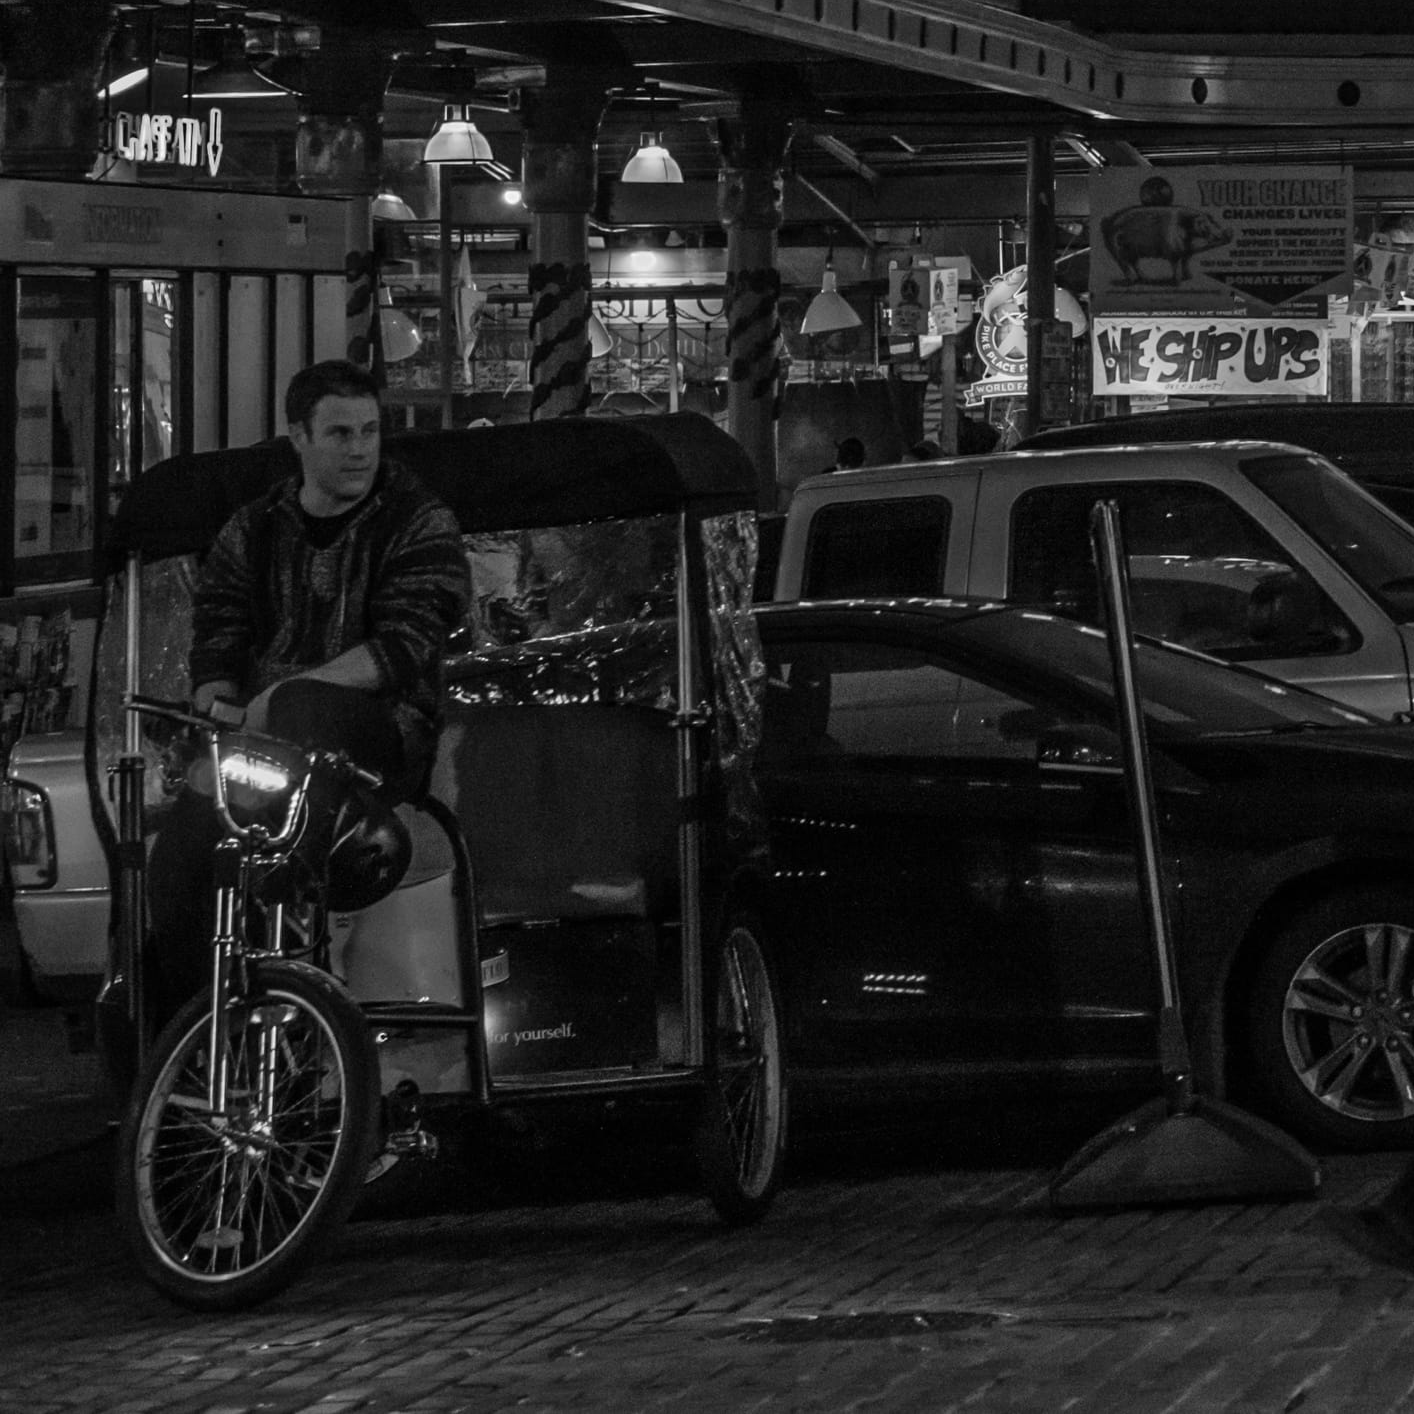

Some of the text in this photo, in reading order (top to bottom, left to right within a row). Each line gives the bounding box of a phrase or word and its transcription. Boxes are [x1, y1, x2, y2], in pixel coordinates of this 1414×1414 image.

[1197, 179, 1347, 206] YOUR CHANGE
[1222, 208, 1346, 220] CHANGES LIVES!
[1241, 228, 1346, 236] YOUR GENEROSITY
[1226, 275, 1280, 285] DONATE
[981, 324, 1017, 374] PIKE PLACE
[1097, 327, 1151, 386] WE
[1244, 326, 1321, 383] UPS
[976, 381, 1016, 393] WORLD
